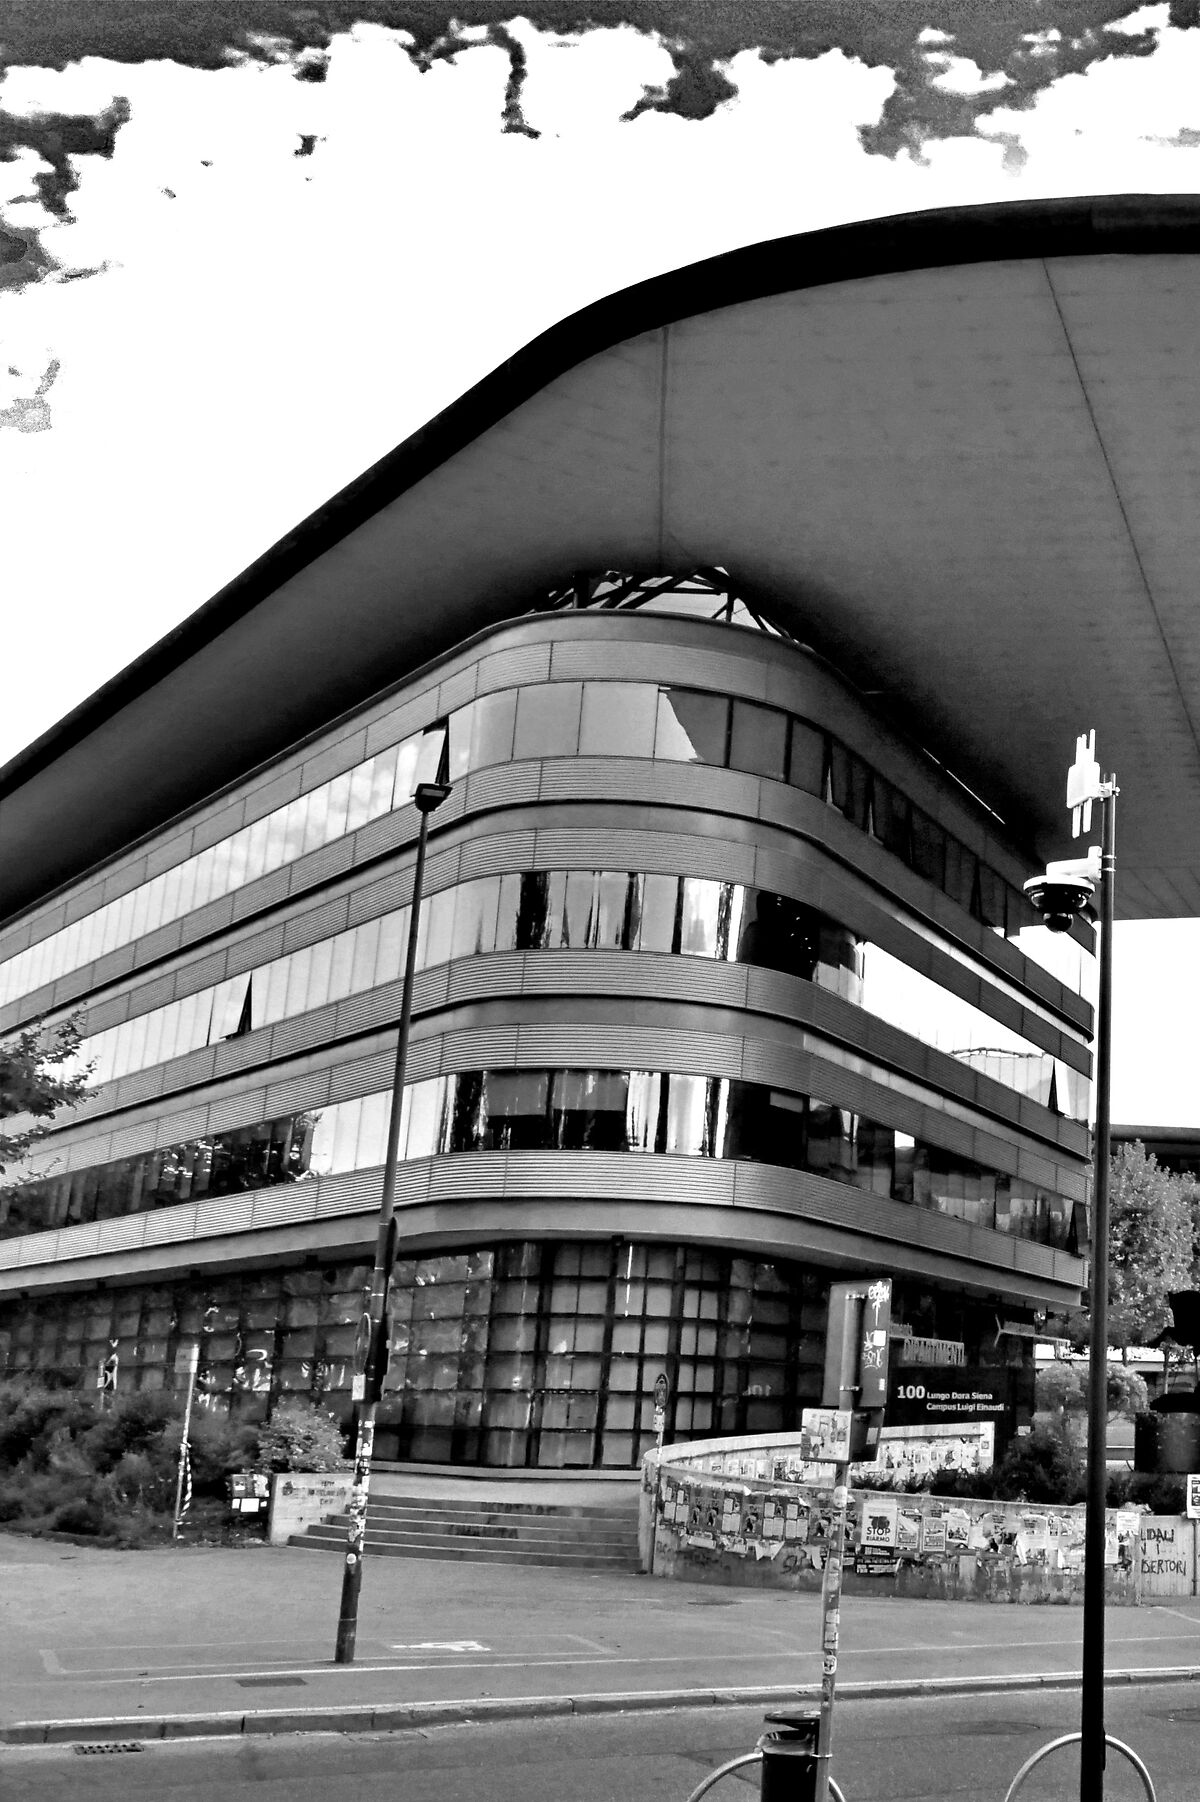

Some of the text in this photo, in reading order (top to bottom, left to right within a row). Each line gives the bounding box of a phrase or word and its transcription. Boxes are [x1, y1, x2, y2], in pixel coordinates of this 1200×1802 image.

[897, 1385, 993, 1401] 100 Lungo Dora Siena
[926, 1402, 1005, 1412] Campus Luigi Einaudi
[866, 1527, 891, 1536] STOP
